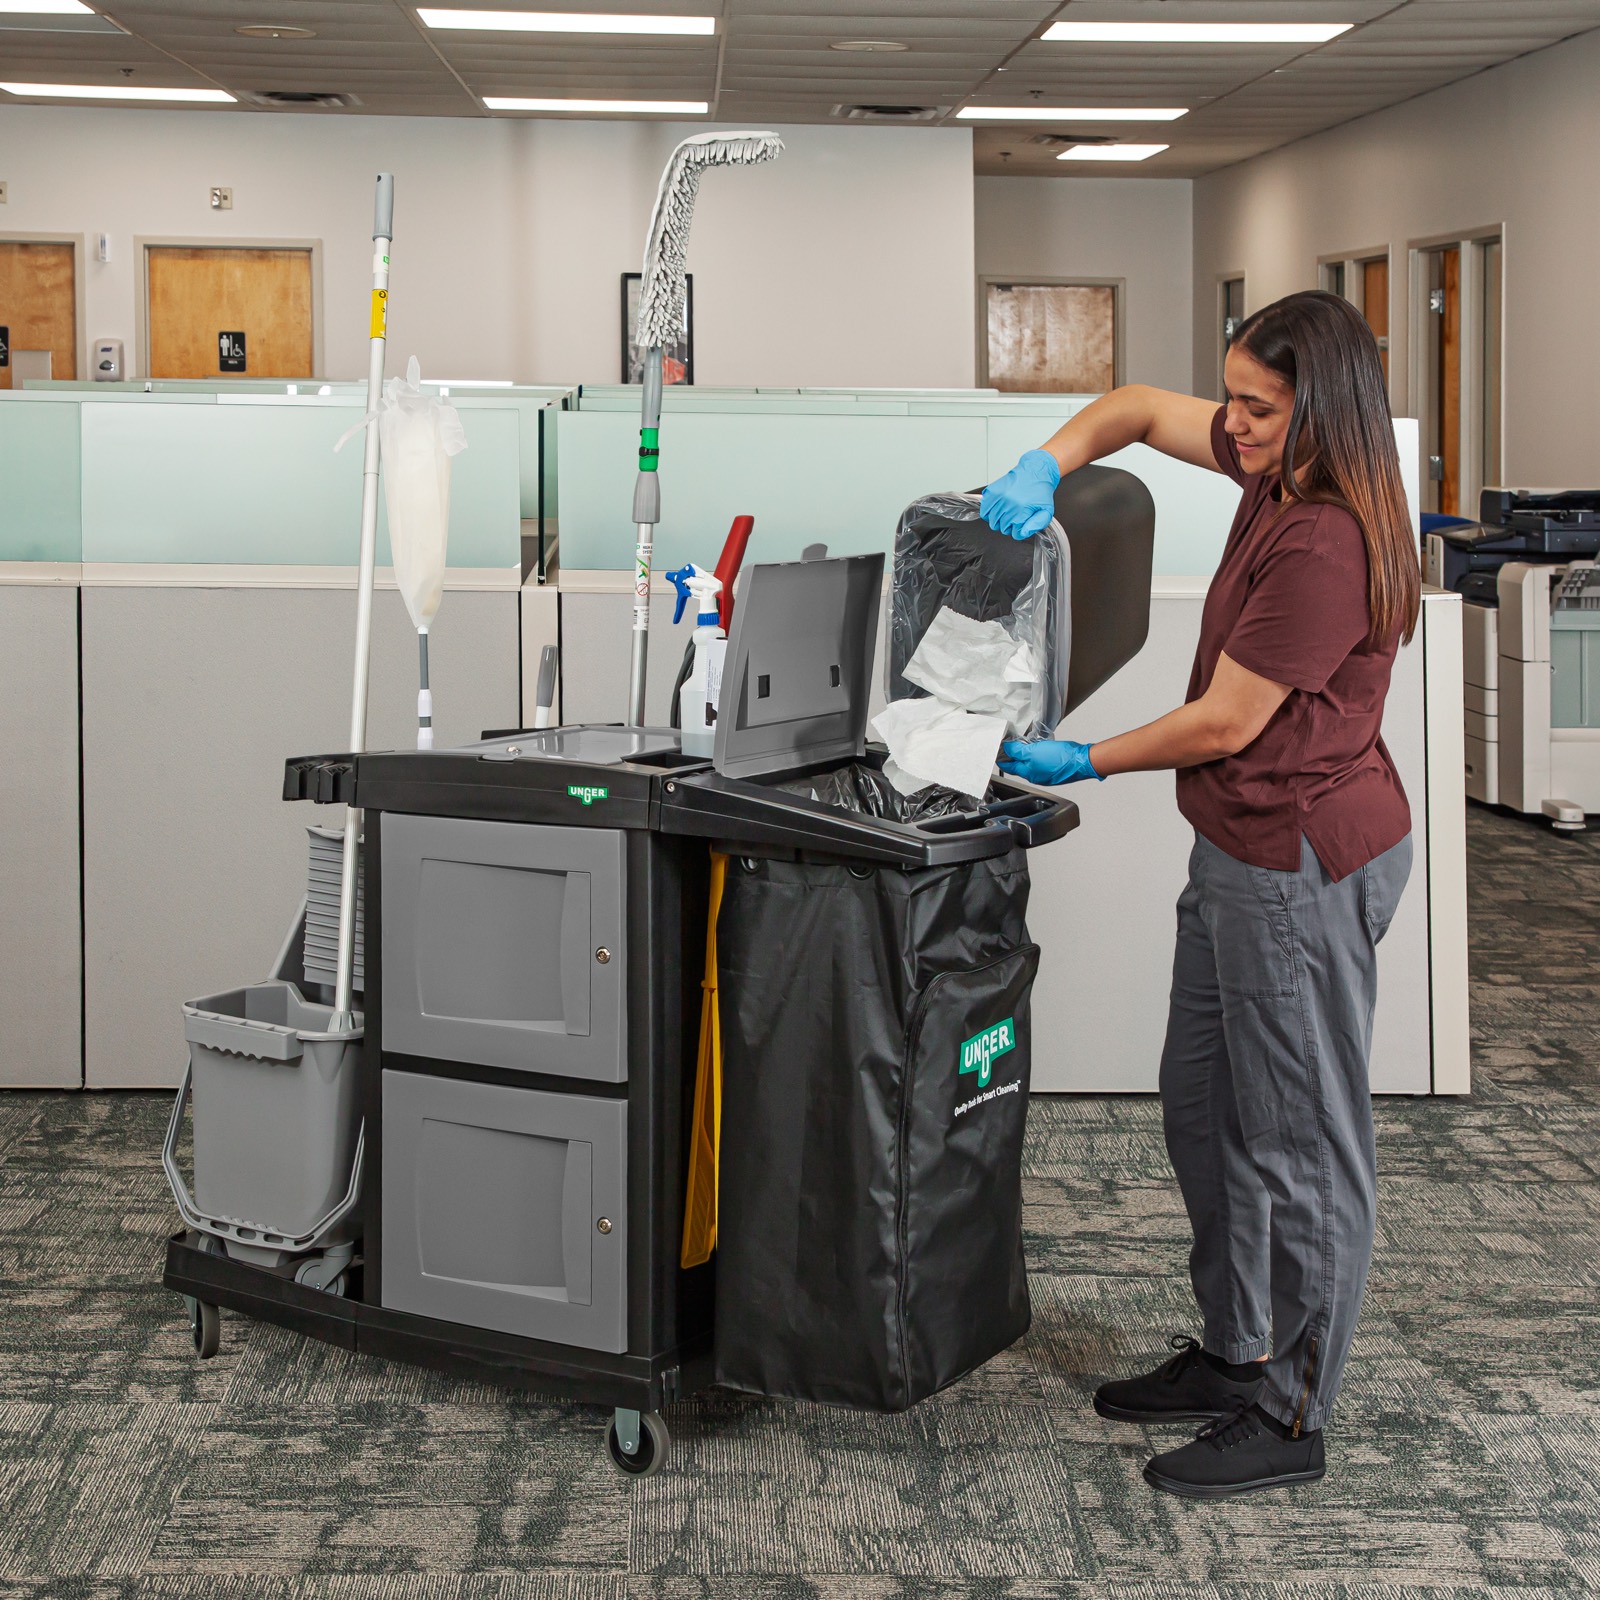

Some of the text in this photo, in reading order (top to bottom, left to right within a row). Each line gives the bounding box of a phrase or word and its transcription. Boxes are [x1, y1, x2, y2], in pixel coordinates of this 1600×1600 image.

[570, 787, 605, 803] UNGER
[964, 1025, 1010, 1079] UNGER
[954, 1103, 968, 1117] Quality
[968, 1097, 977, 1109] Tools
[983, 1089, 996, 1101] Smart
